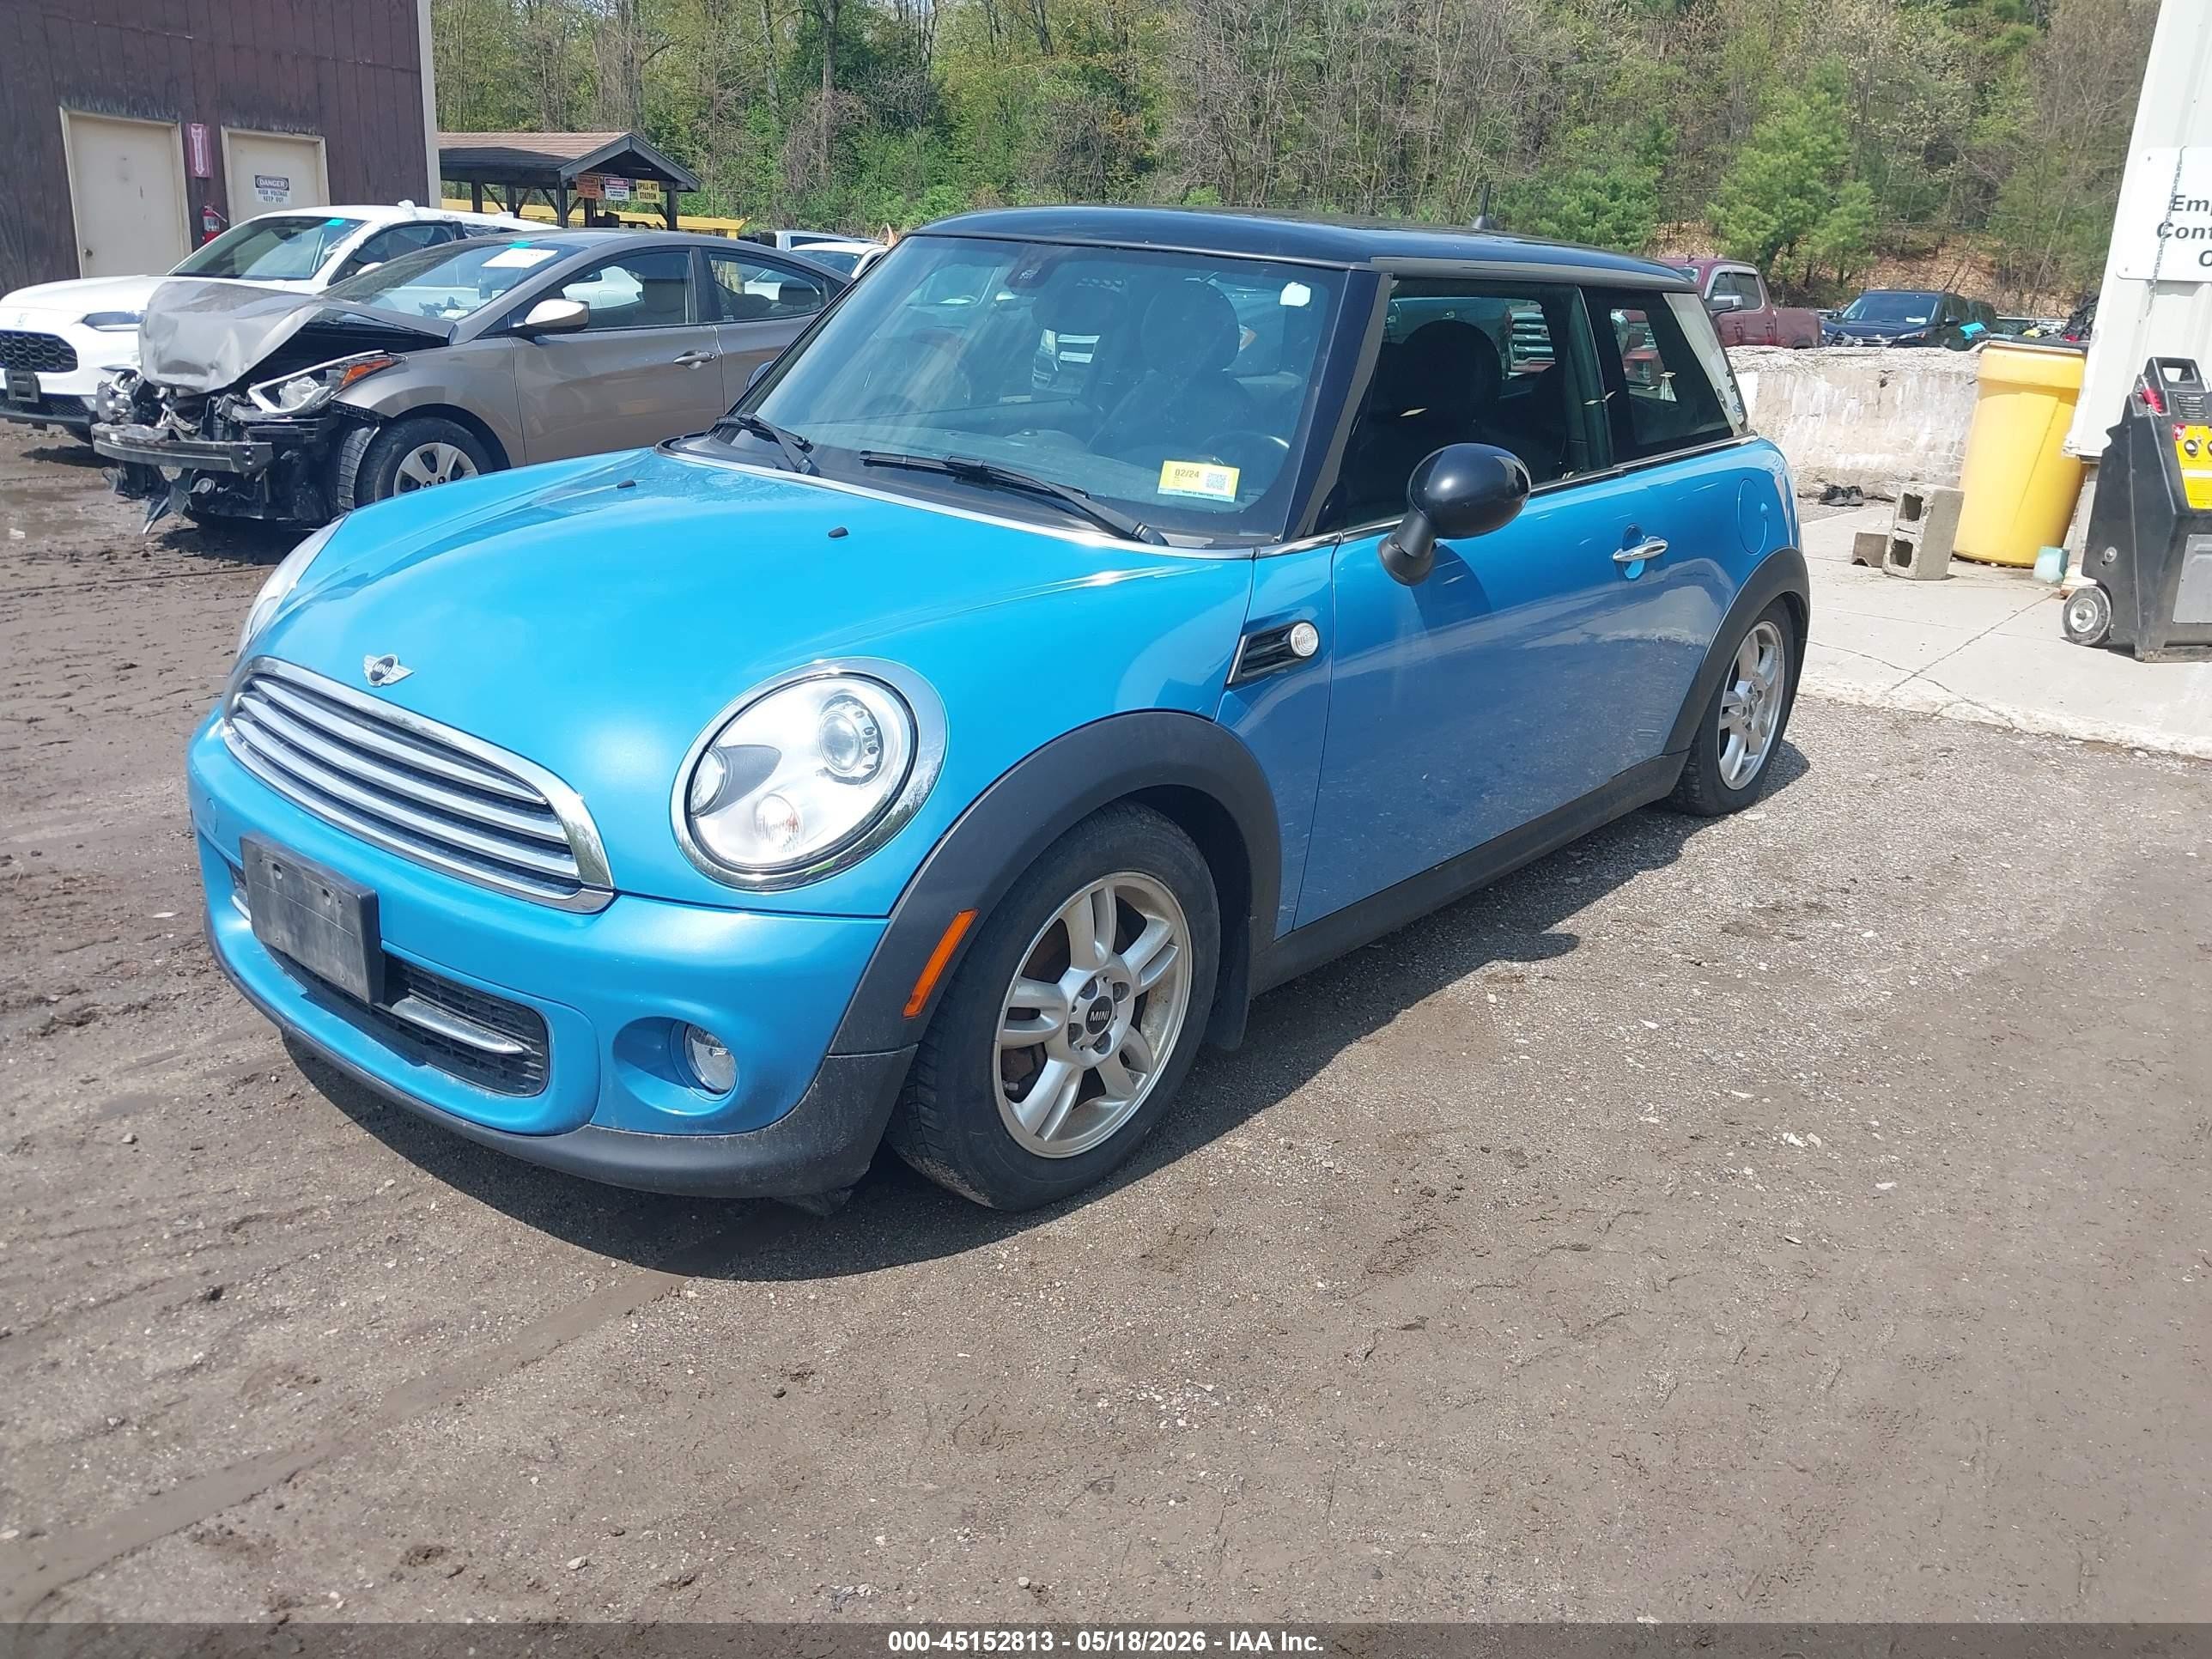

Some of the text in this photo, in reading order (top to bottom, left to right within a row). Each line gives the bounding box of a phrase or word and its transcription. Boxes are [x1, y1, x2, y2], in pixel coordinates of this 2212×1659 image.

[259, 179, 285, 187] DANGER
[1175, 468, 1200, 479] 02/24
[373, 662, 392, 675] MINI
[1090, 1010, 1110, 1022] MINI
